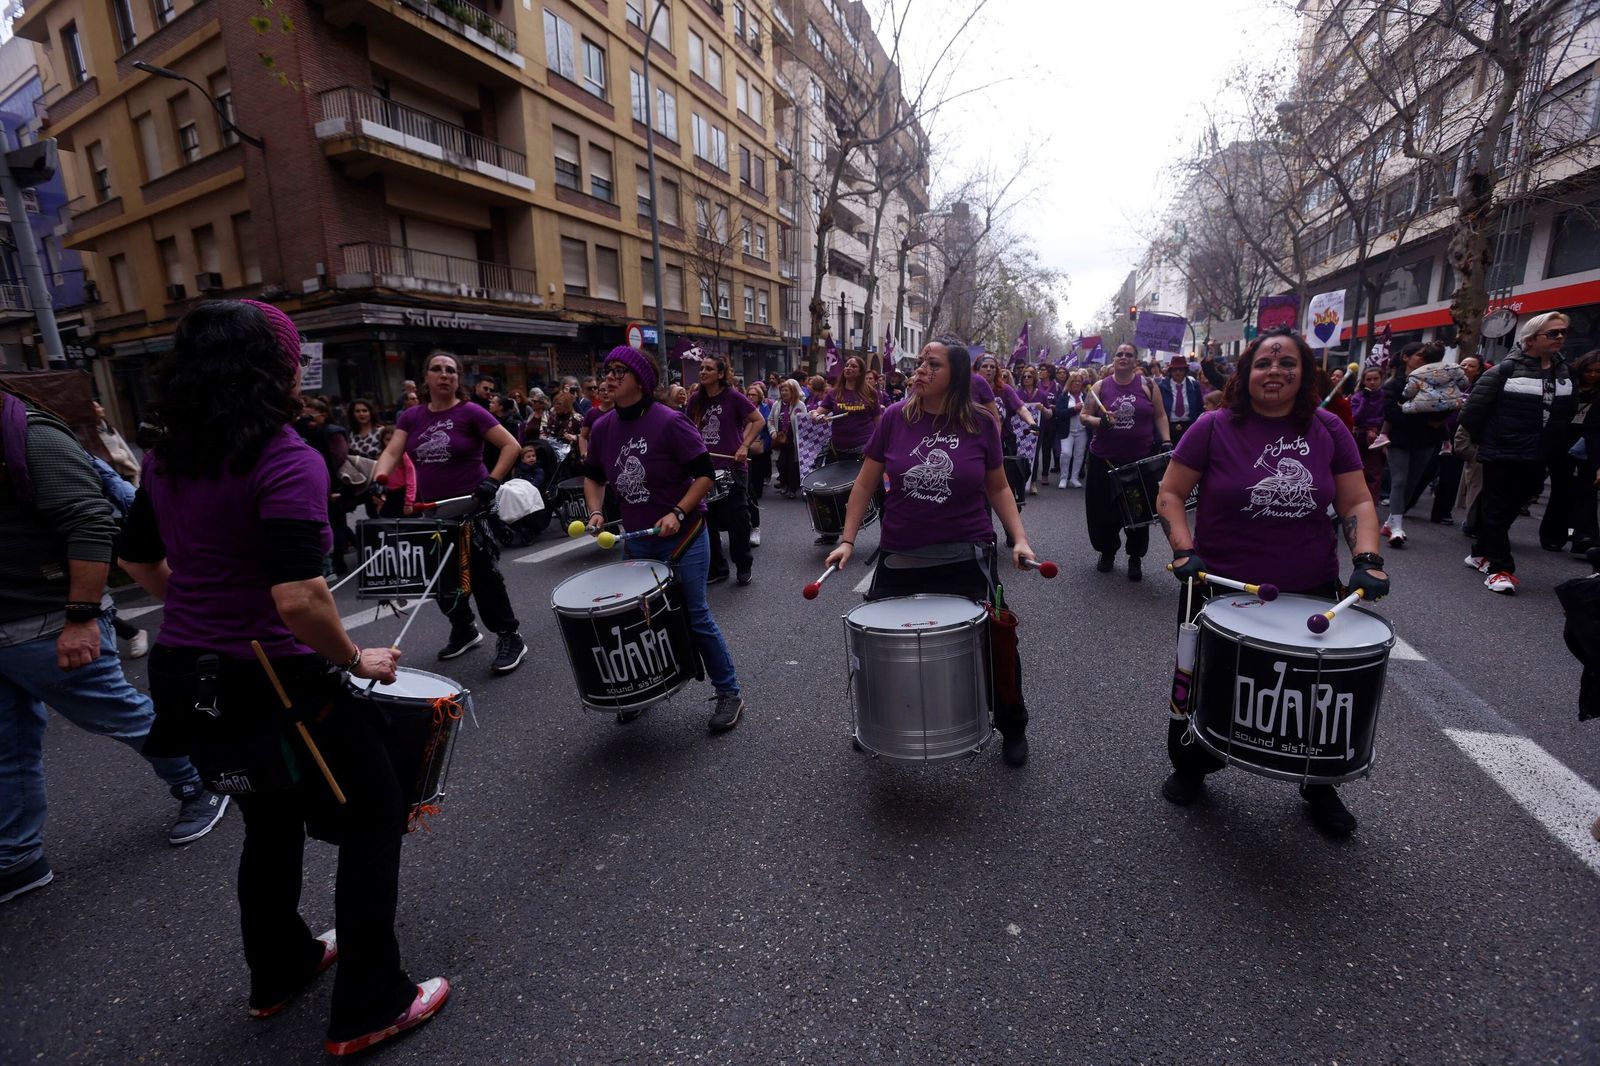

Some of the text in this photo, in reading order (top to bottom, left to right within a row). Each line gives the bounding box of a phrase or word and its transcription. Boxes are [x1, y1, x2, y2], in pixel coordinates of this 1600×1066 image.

[1271, 435, 1311, 458] Juntas
[606, 682, 634, 695] sound
[1234, 730, 1324, 757] sound sister
